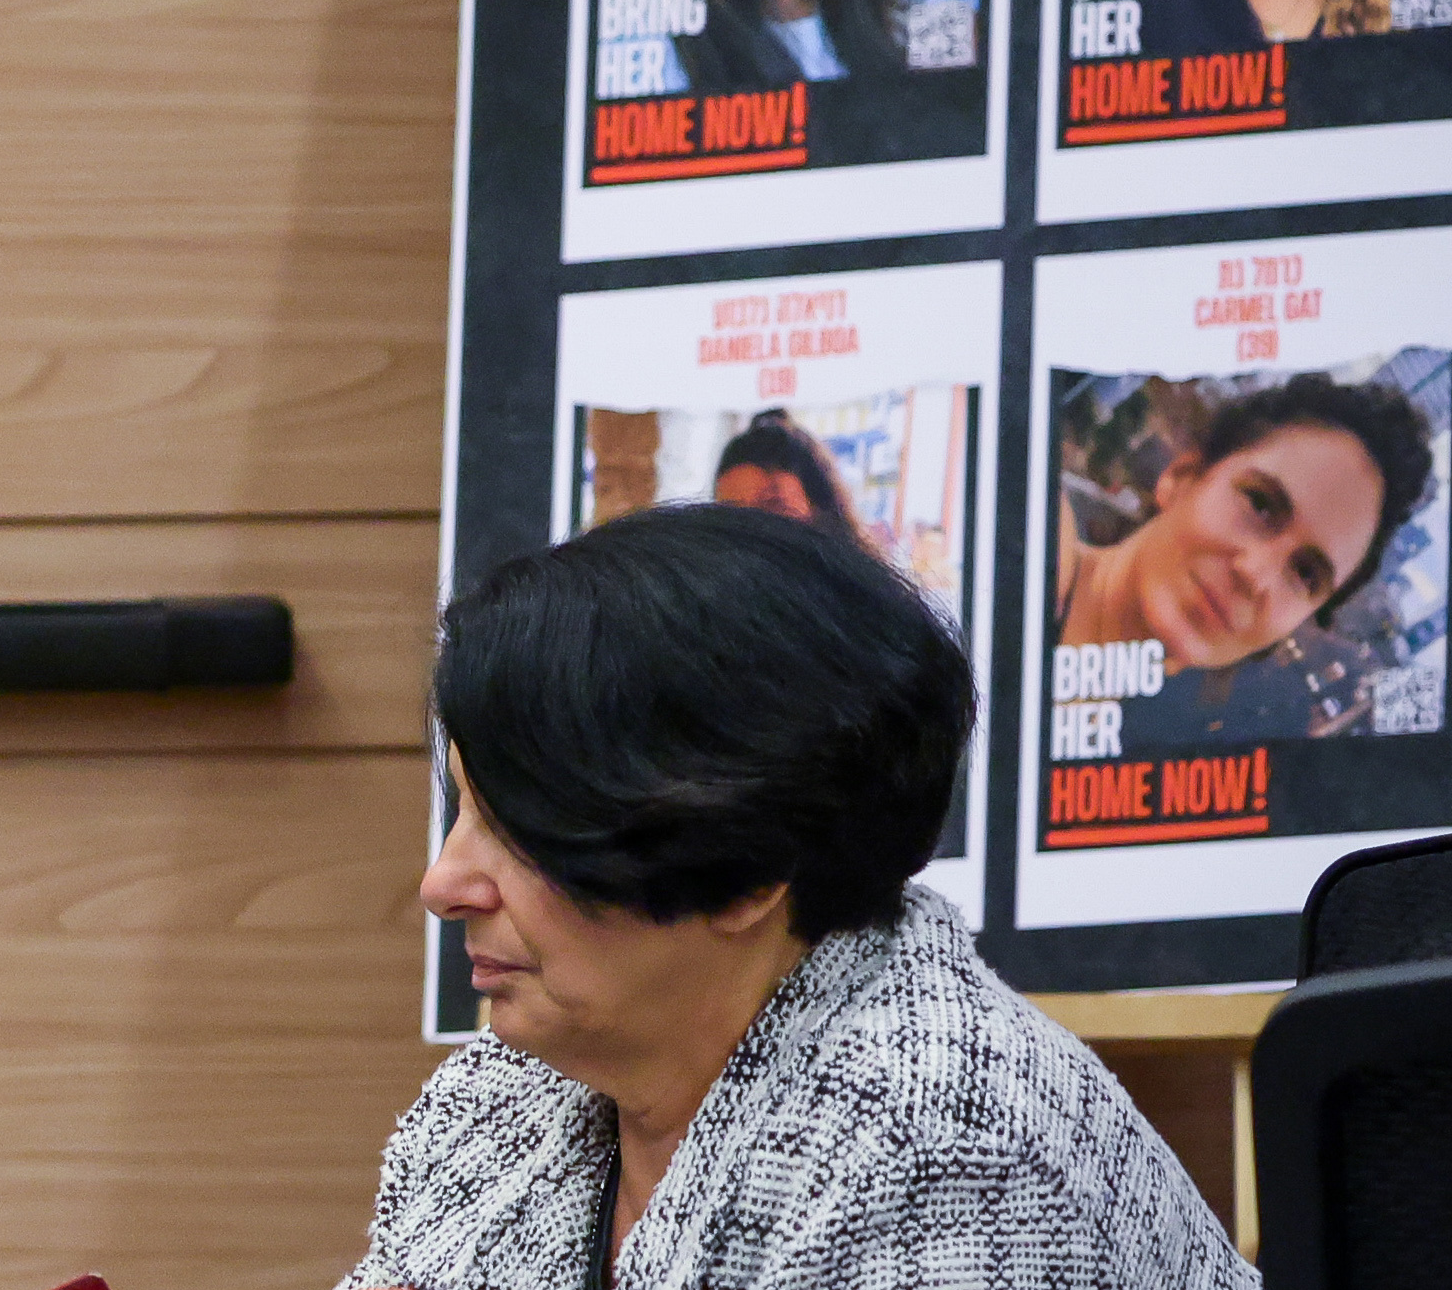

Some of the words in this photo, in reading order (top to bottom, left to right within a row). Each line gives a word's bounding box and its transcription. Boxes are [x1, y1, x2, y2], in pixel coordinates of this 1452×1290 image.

[1070, 0, 1142, 59] HER
[596, 40, 665, 100] HER
[1070, 59, 1172, 121] HOME
[1180, 43, 1285, 111] NOW!
[596, 99, 695, 159] HOME
[703, 82, 806, 151] NOW!
[1052, 639, 1164, 702] BRING
[1050, 700, 1122, 761] HER
[1050, 761, 1154, 825] HOME
[1161, 747, 1268, 817] NOW!
